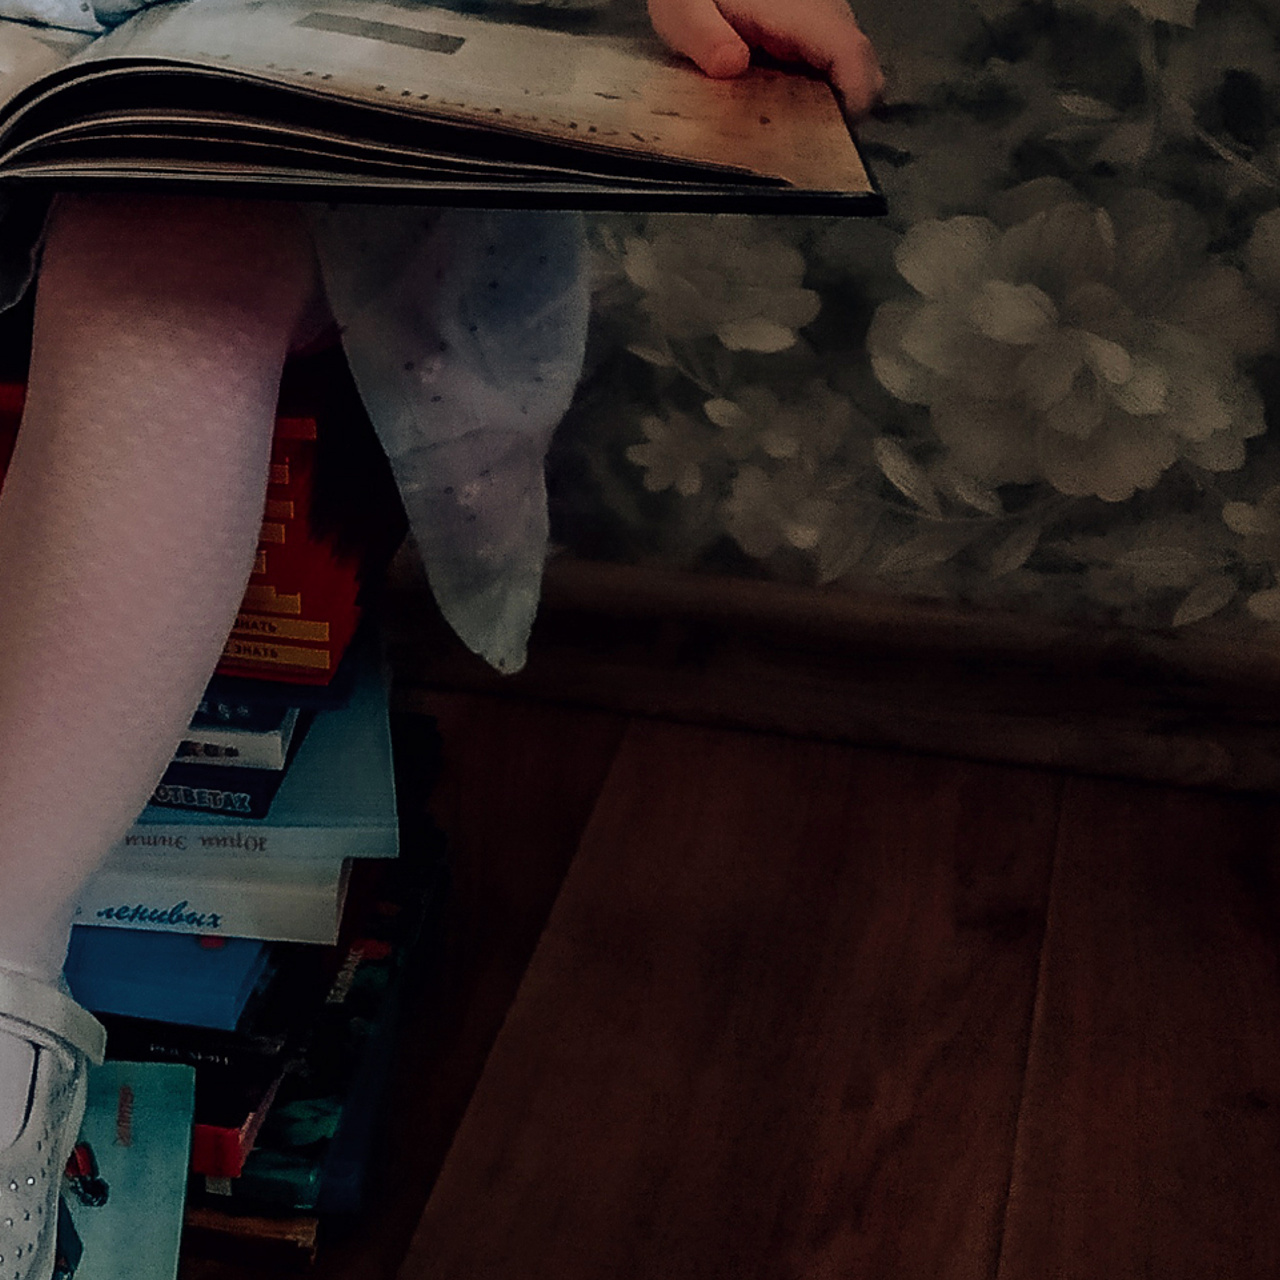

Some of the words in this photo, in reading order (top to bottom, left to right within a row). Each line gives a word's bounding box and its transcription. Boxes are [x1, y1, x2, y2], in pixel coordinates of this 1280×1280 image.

[154, 783, 253, 813] ОТВЕТАХ
[125, 834, 188, 851] Энти
[96, 900, 223, 929] ленивых
